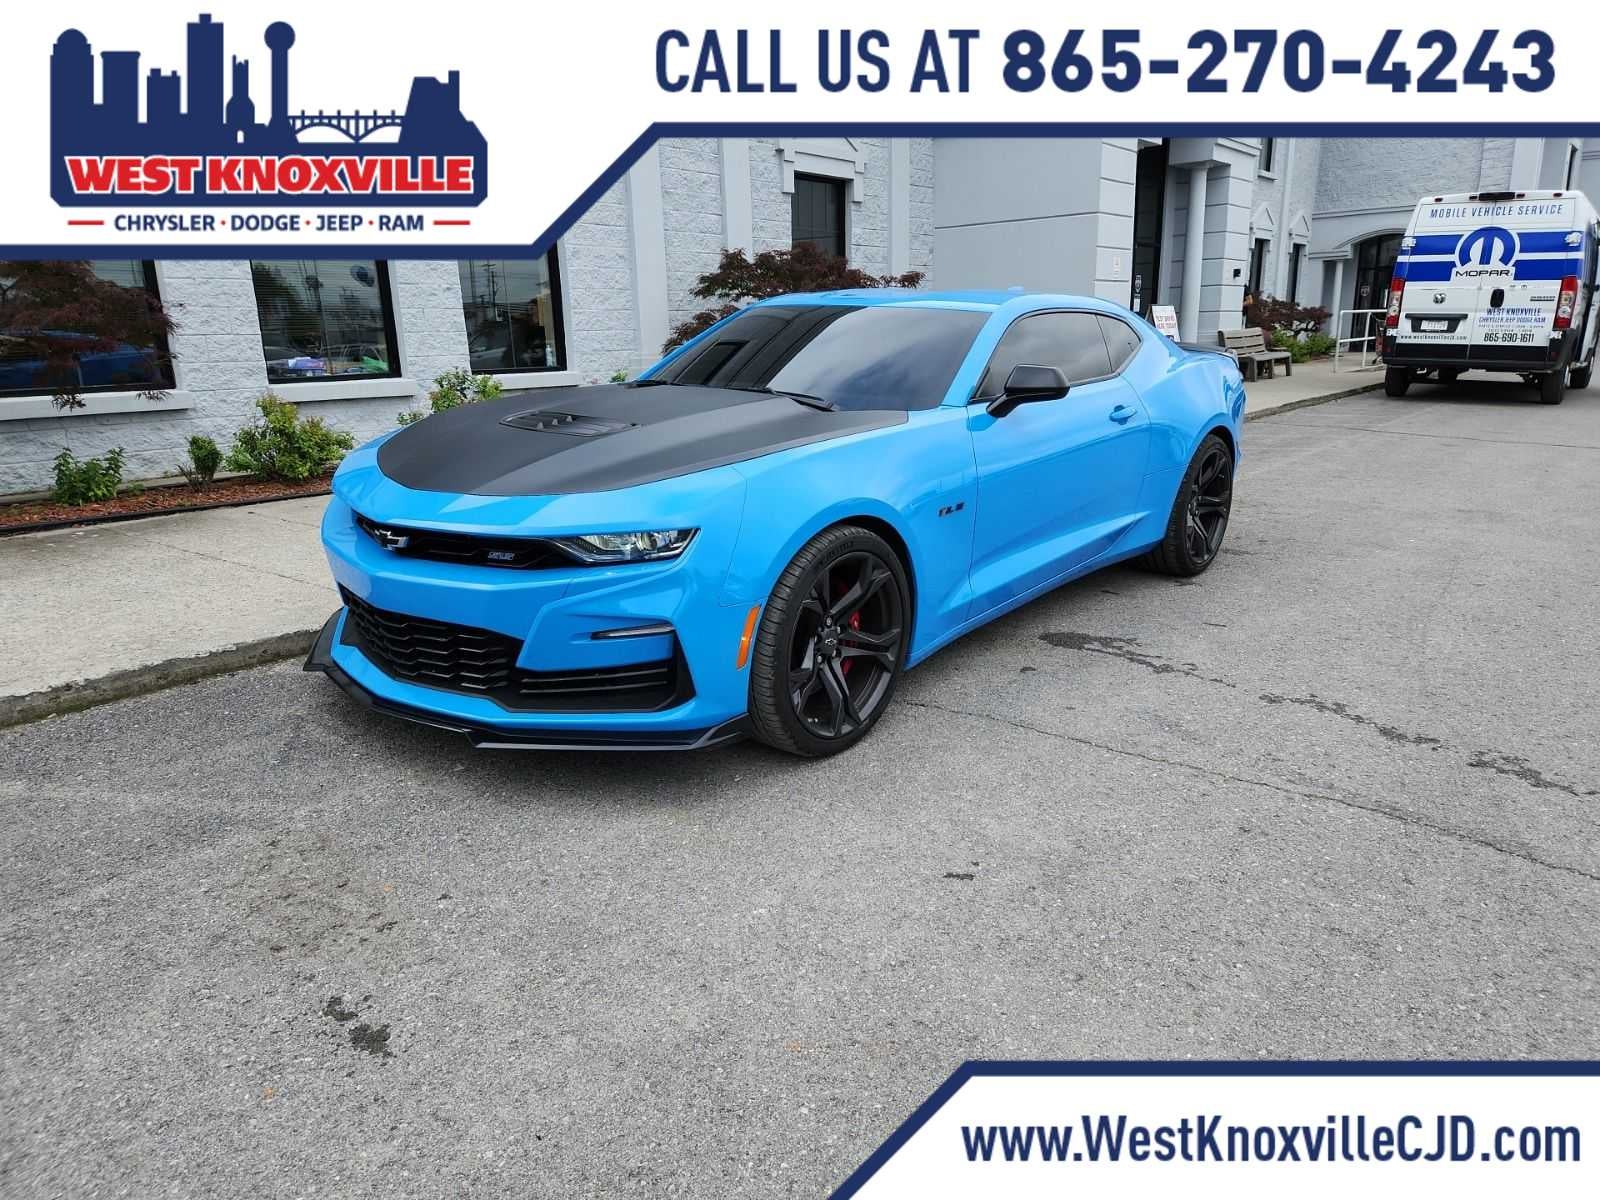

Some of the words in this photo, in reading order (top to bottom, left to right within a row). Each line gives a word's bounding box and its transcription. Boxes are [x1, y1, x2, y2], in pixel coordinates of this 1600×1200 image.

[1430, 206, 1467, 218] MOBILE
[1471, 205, 1514, 217] VEHICLE
[1517, 203, 1563, 216] SERVICE
[1455, 269, 1511, 278] MOPAR
